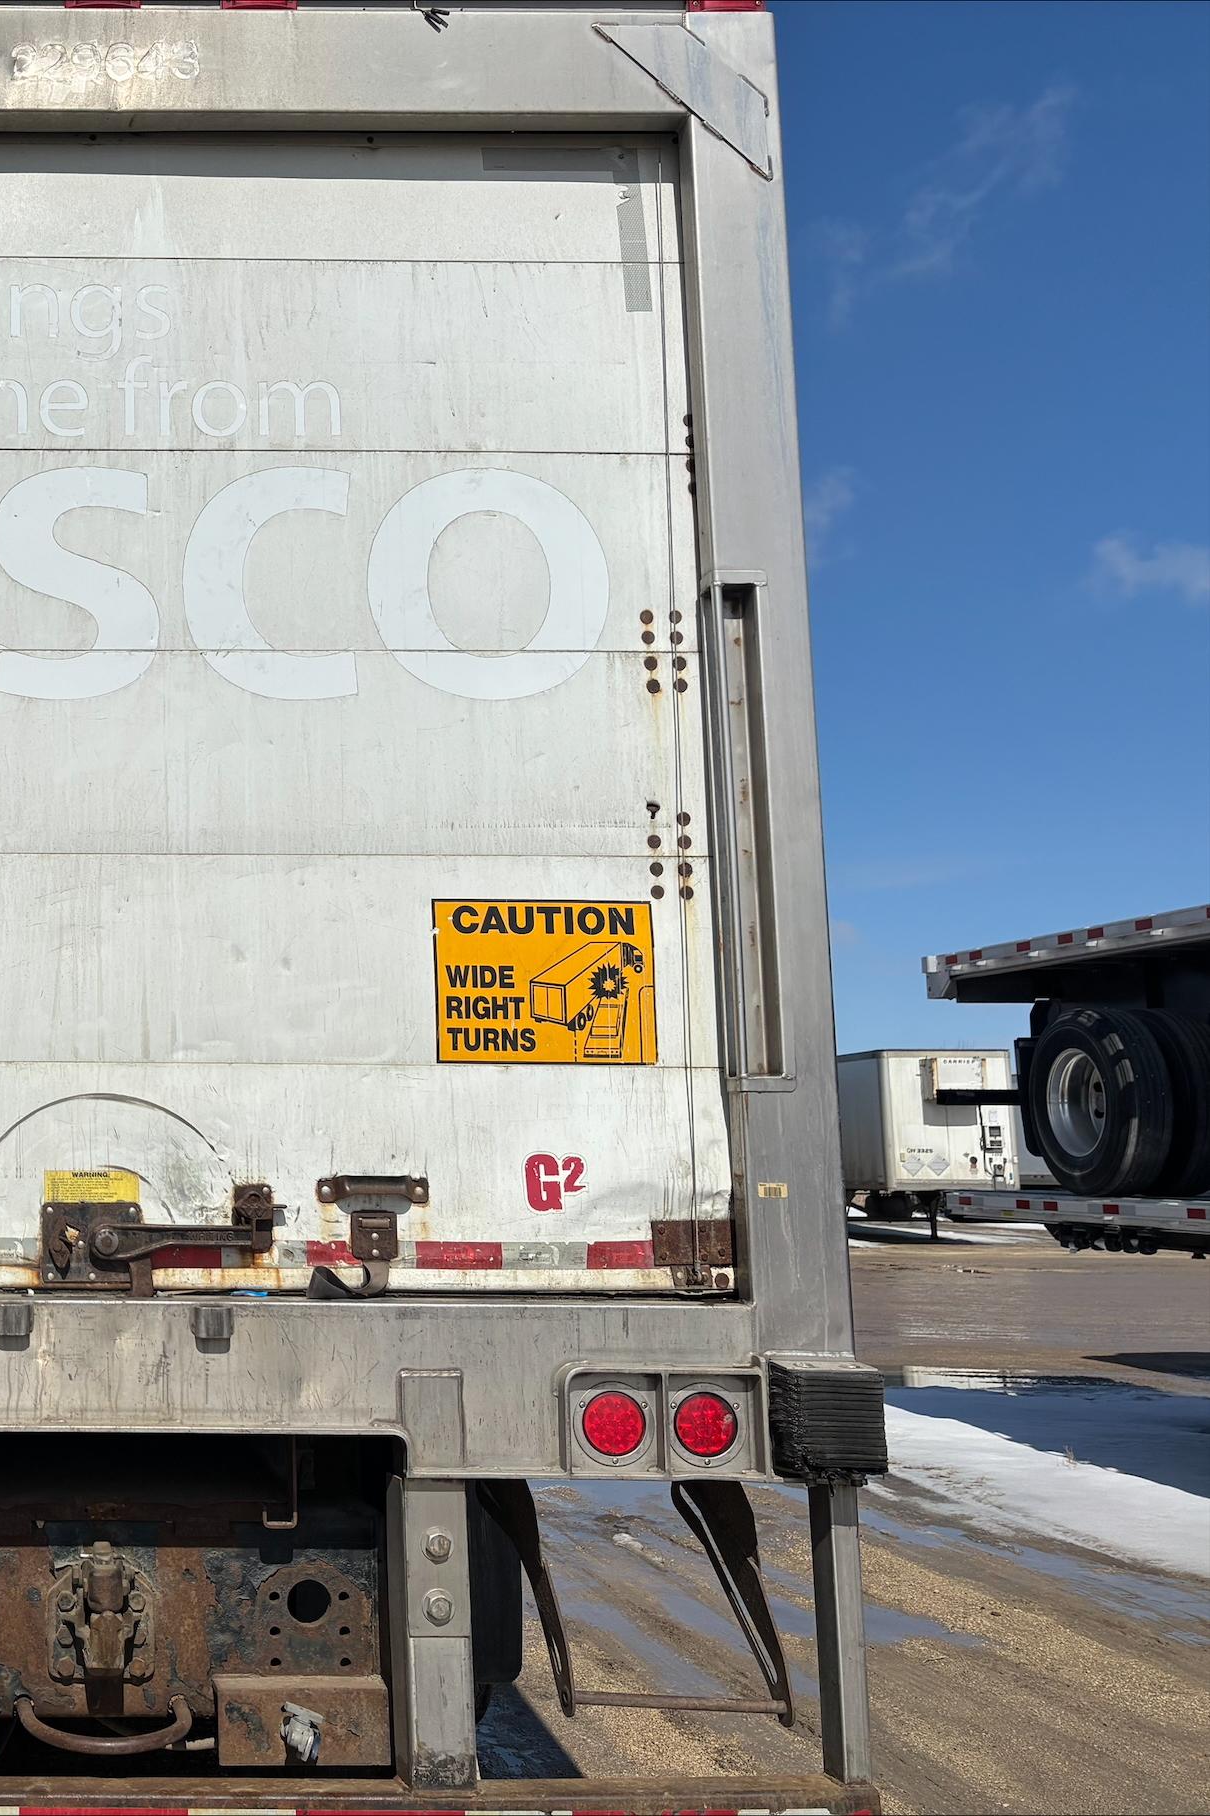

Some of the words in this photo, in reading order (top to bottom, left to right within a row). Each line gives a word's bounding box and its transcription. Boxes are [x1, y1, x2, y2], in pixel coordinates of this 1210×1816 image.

[116, 355, 342, 438] from
[452, 905, 635, 936] CAUTION
[445, 965, 515, 989] WIDE
[446, 996, 525, 1020] RIGHT
[447, 1027, 537, 1052] TURNS
